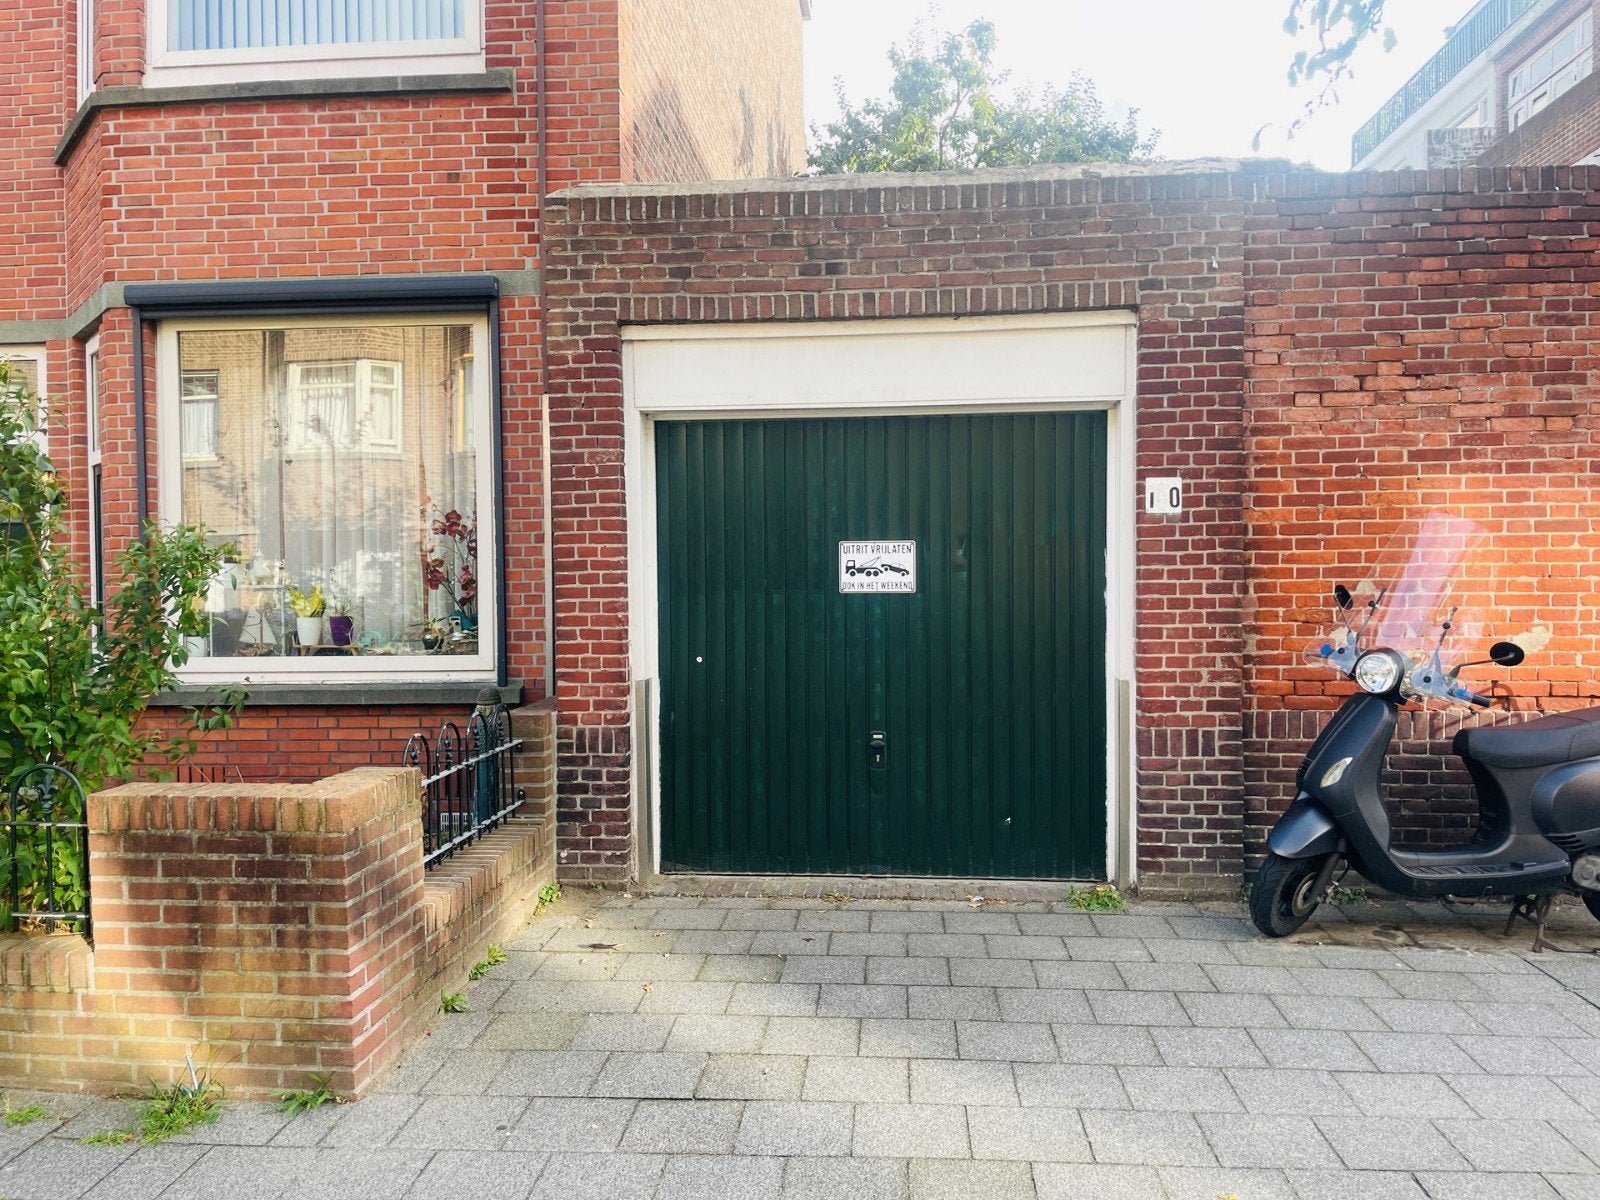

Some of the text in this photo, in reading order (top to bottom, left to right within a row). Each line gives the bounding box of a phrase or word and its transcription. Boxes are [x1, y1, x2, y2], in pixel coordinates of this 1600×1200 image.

[843, 545, 912, 554] UITRIT VRIJLATEN
[842, 582, 913, 590] OOK IN HET WEEKEND
